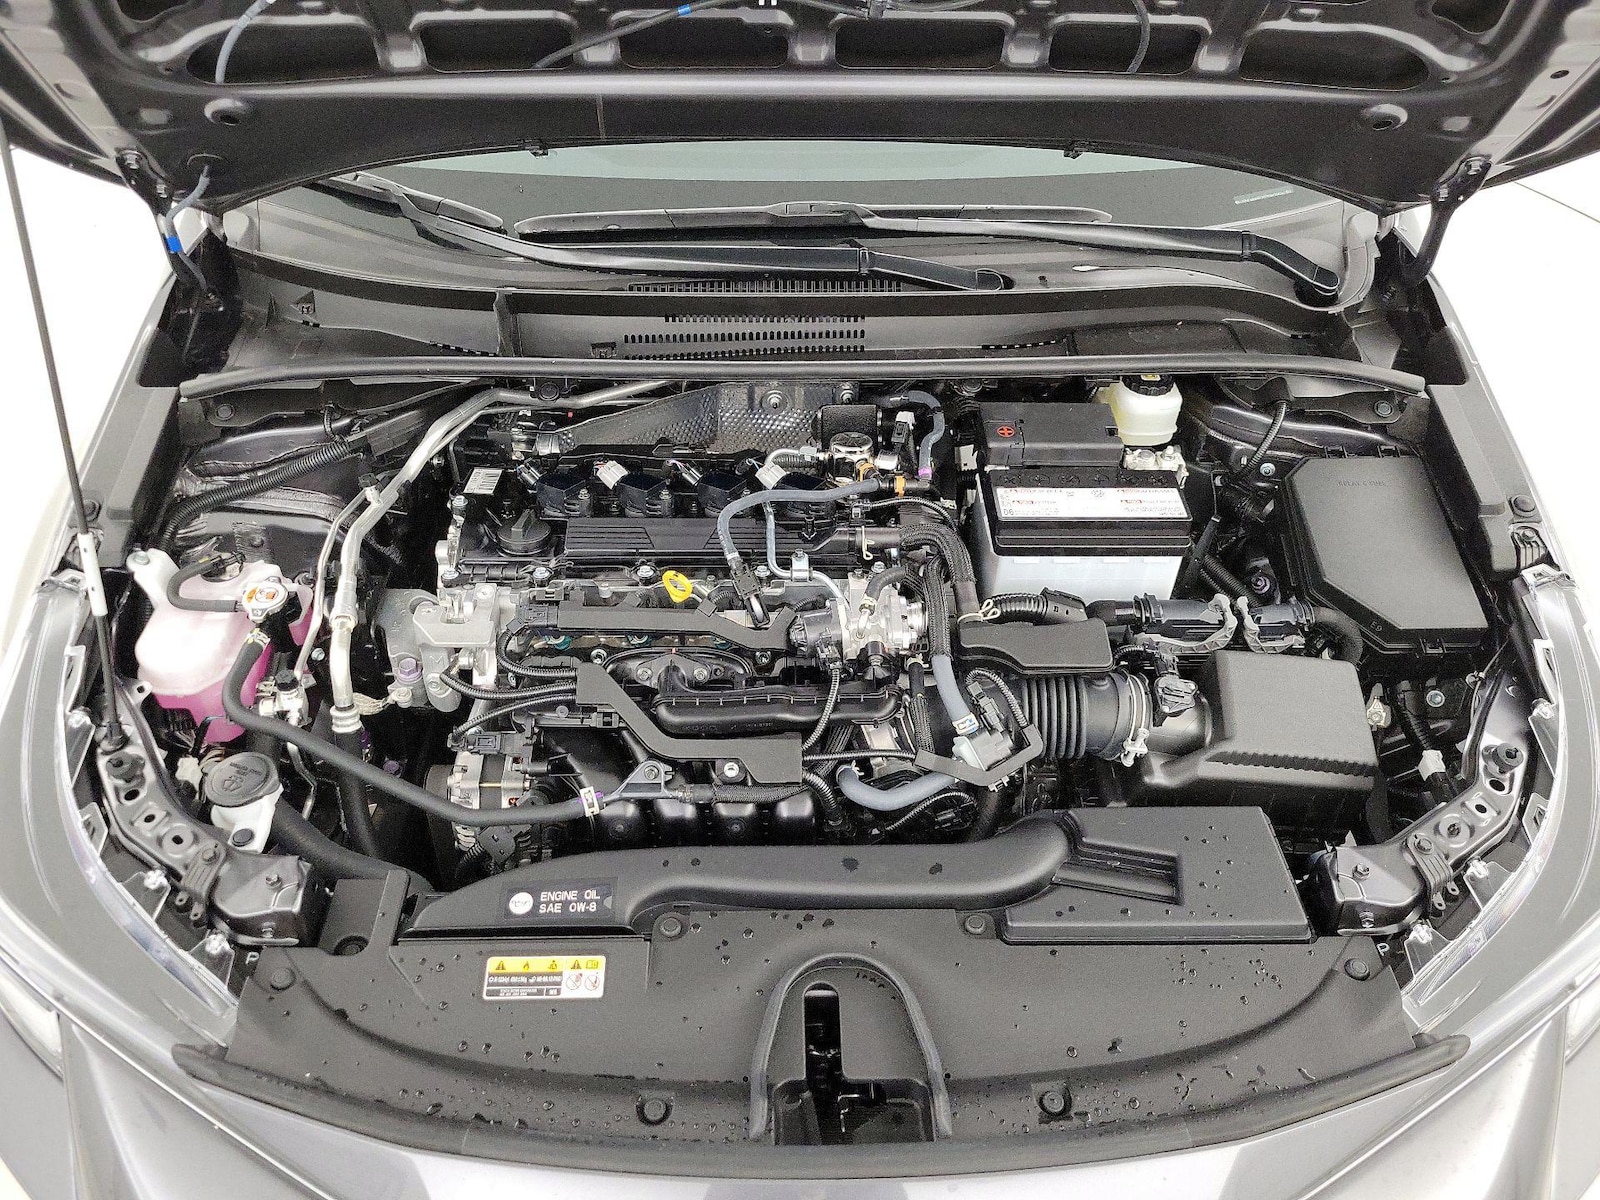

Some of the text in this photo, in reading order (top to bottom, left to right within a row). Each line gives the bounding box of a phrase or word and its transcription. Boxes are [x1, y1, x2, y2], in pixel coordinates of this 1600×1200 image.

[1370, 619, 1383, 632] E9
[540, 889, 601, 902] ENGINE OIL
[539, 901, 597, 913] SAE 0W-8
